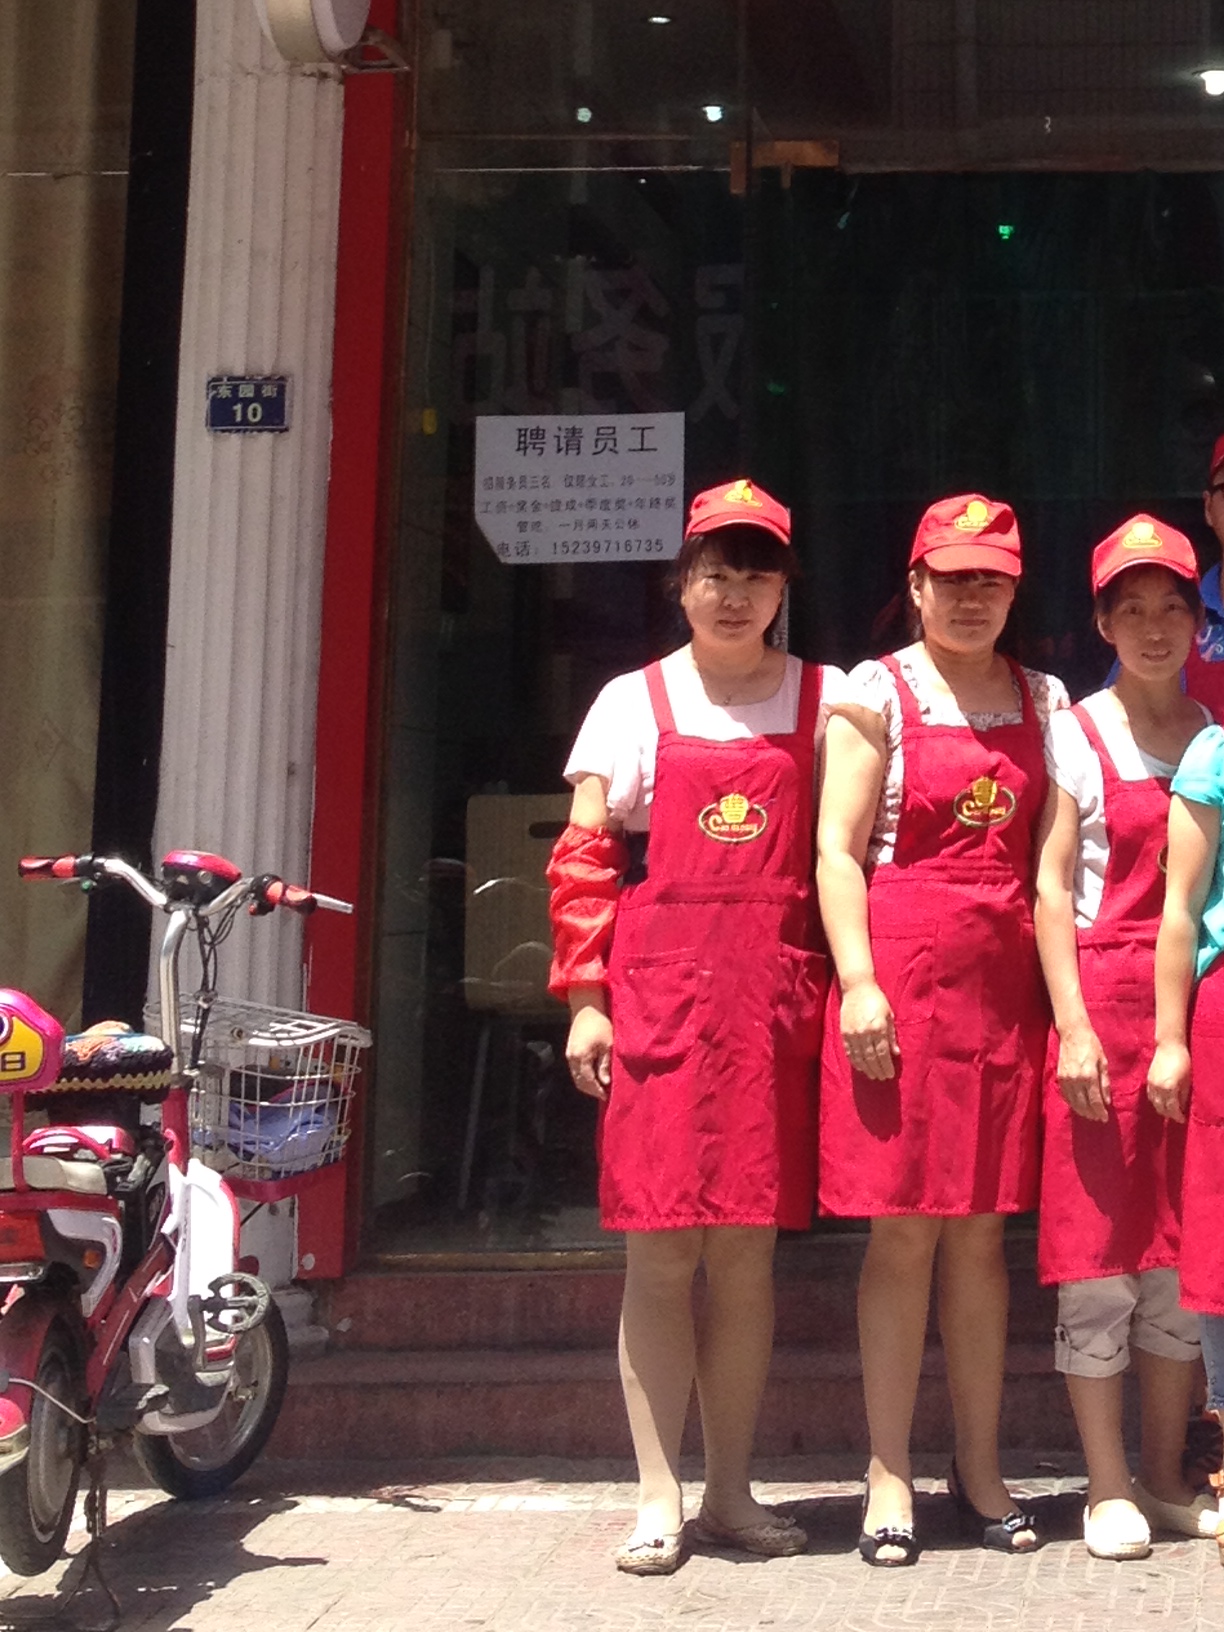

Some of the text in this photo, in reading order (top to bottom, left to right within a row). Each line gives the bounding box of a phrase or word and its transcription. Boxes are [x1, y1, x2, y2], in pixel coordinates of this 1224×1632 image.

[232, 402, 263, 423] 10
[515, 425, 658, 456] 聘请员工
